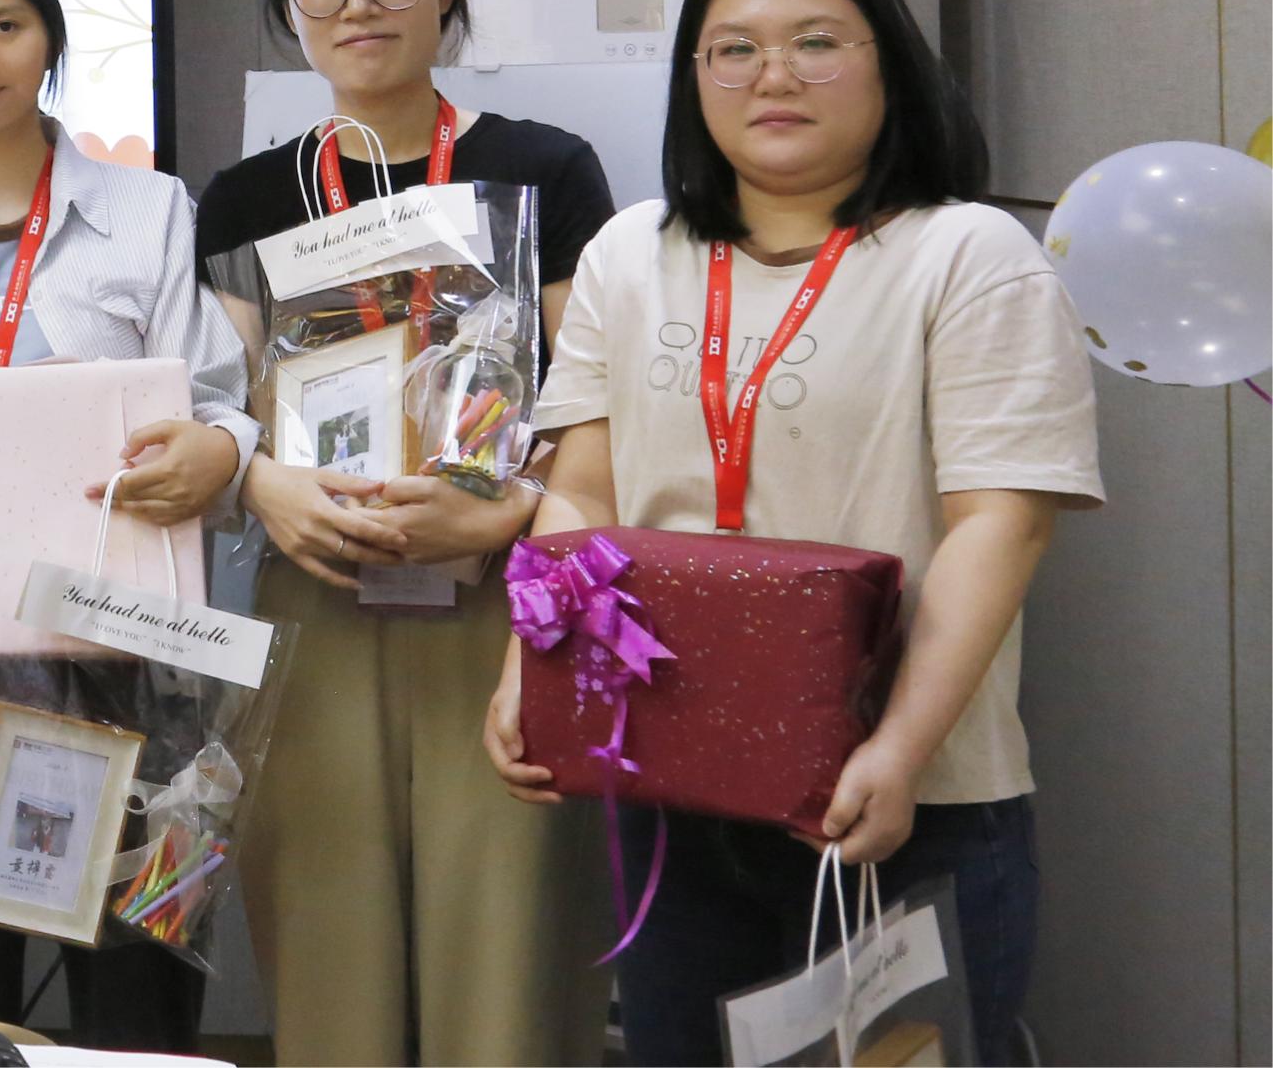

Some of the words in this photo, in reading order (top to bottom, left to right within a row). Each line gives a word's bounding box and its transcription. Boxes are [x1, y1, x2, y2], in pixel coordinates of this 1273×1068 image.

[292, 238, 318, 259] You
[322, 223, 351, 249] had
[353, 221, 375, 237] me
[62, 583, 97, 608] You
[98, 595, 140, 620] had
[137, 612, 164, 626] me
[186, 620, 234, 646] hello
